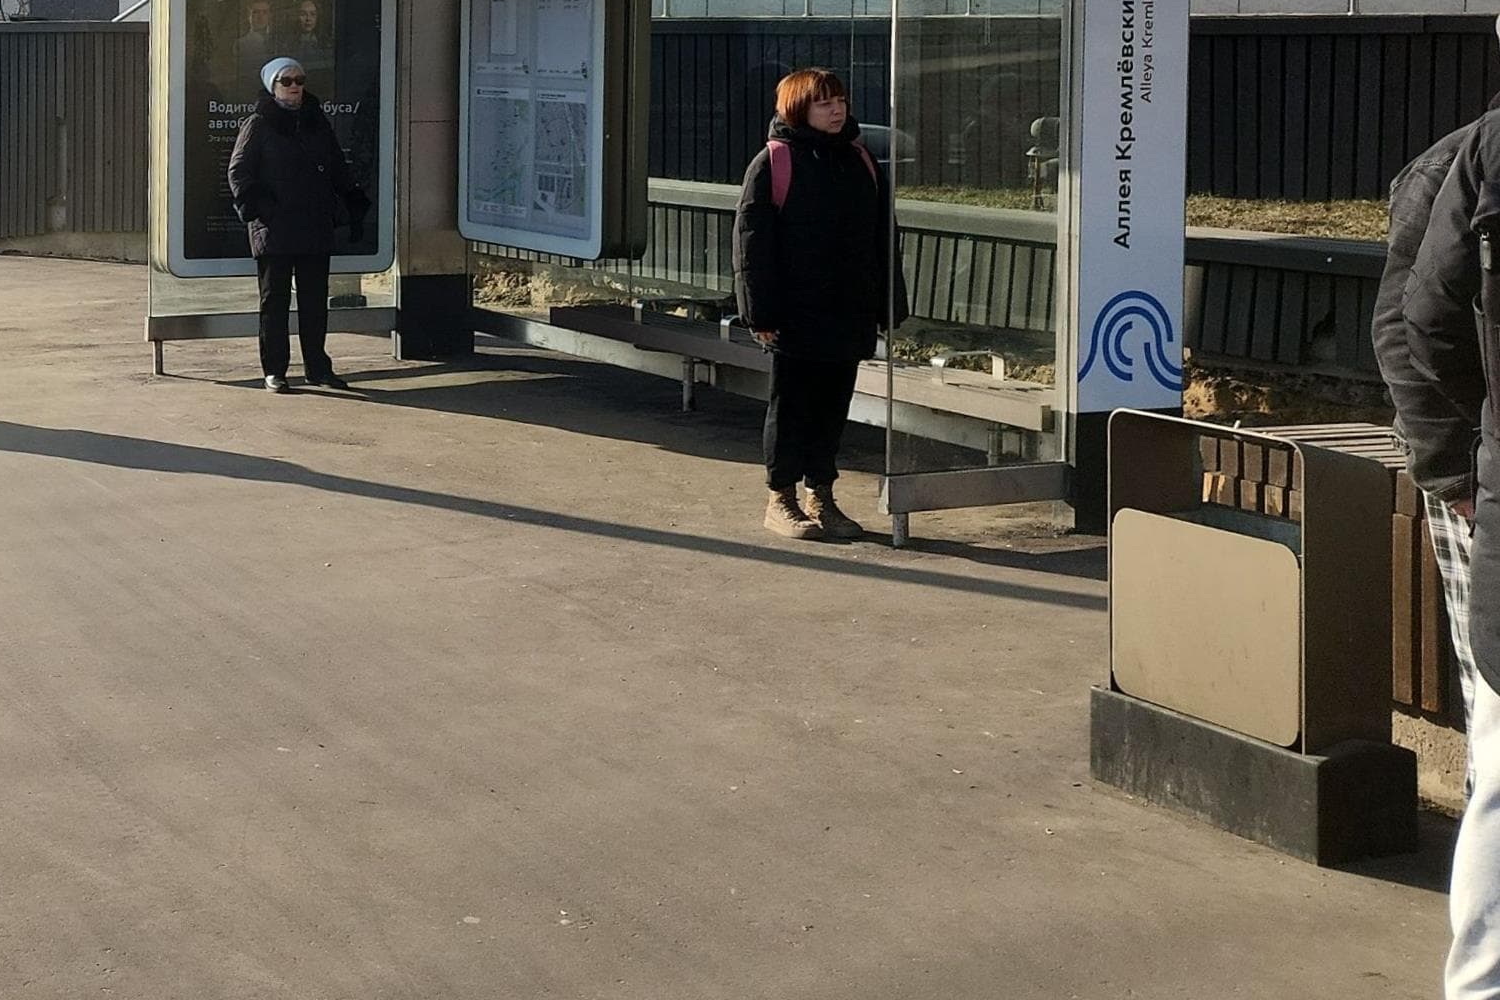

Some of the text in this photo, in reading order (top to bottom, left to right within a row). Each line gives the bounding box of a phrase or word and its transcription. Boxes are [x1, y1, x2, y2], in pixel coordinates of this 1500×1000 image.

[1140, 54, 1155, 104] Alleya
[208, 101, 257, 114] Водите
[208, 116, 244, 129] автоб
[1113, 169, 1132, 249] Аллея
